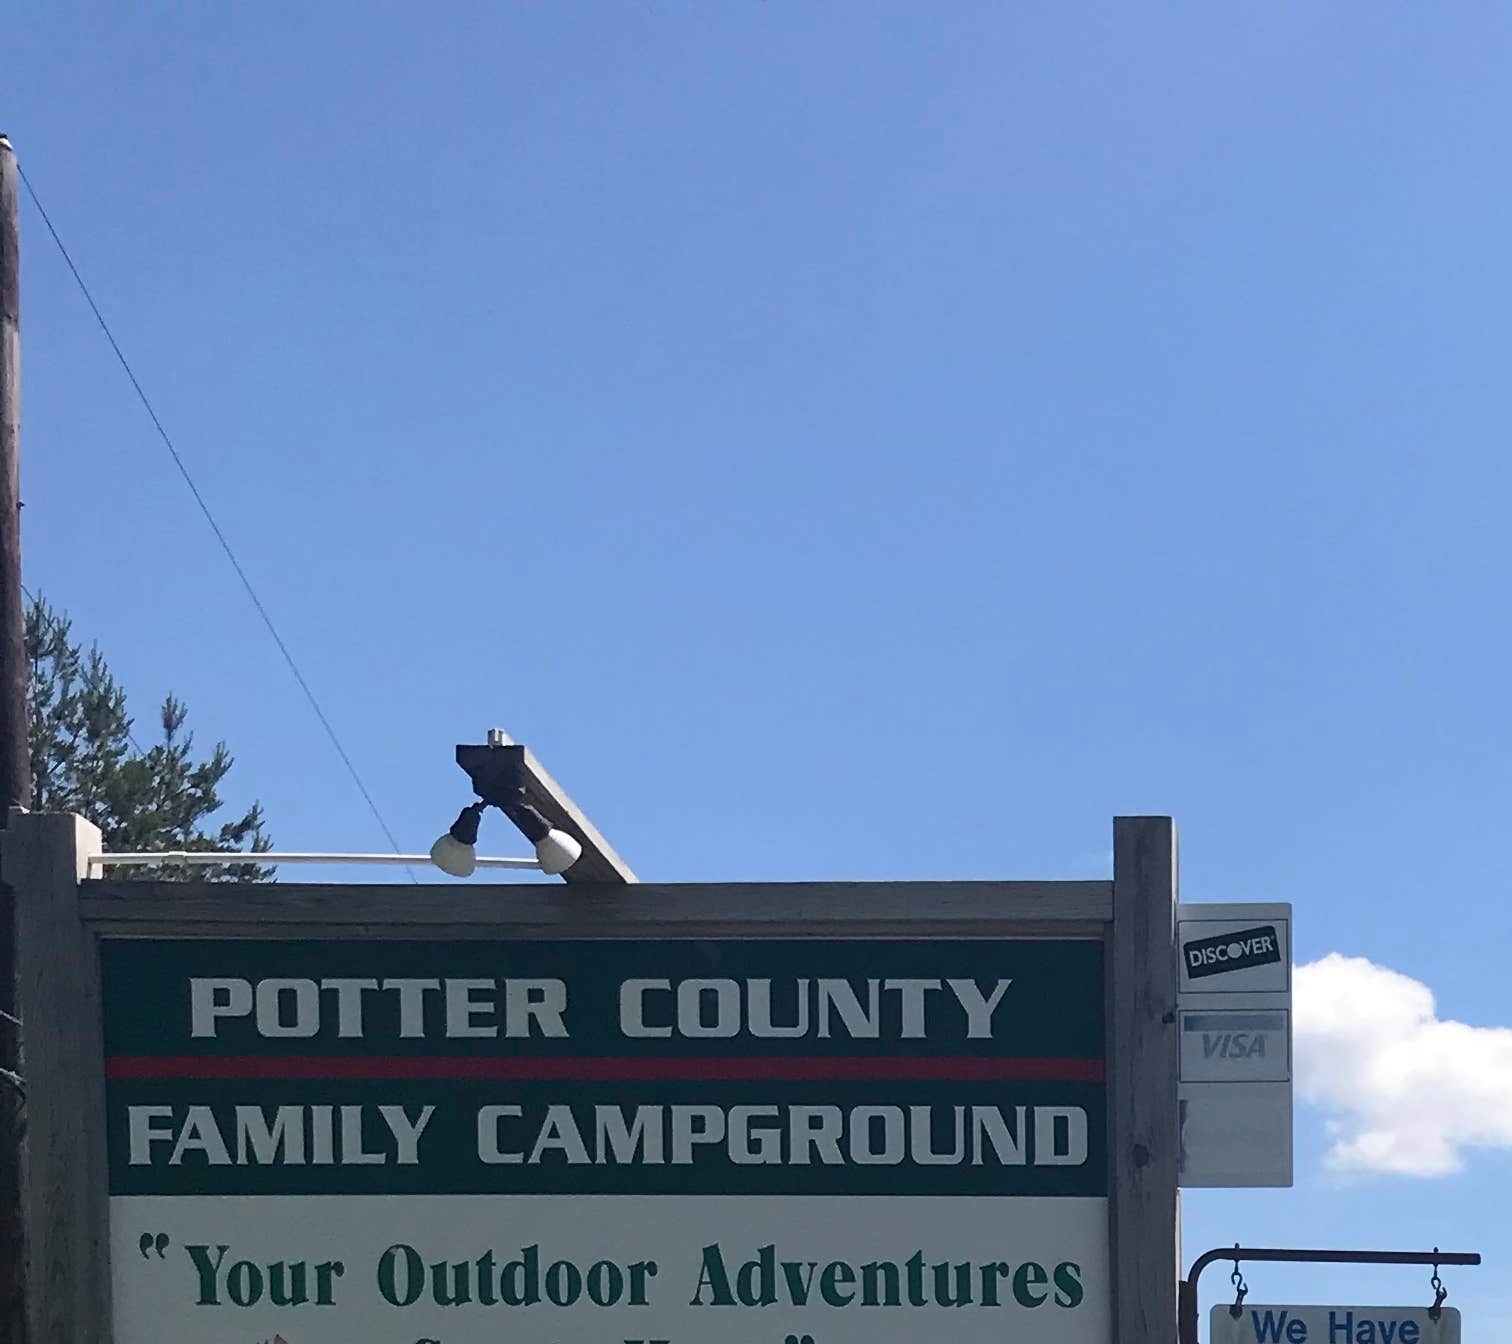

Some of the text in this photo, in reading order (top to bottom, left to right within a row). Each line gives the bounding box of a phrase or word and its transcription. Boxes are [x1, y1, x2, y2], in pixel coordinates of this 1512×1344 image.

[1189, 935, 1274, 967] DISCOVER
[190, 978, 1012, 1038] POTTER COUNTY
[1203, 1034, 1265, 1058] VISA
[128, 1105, 1087, 1165] FAMILY CAMPGROUND
[378, 1244, 657, 1306] Outdoor
[689, 1243, 1083, 1308] Adventures
[1251, 1310, 1307, 1344] We
